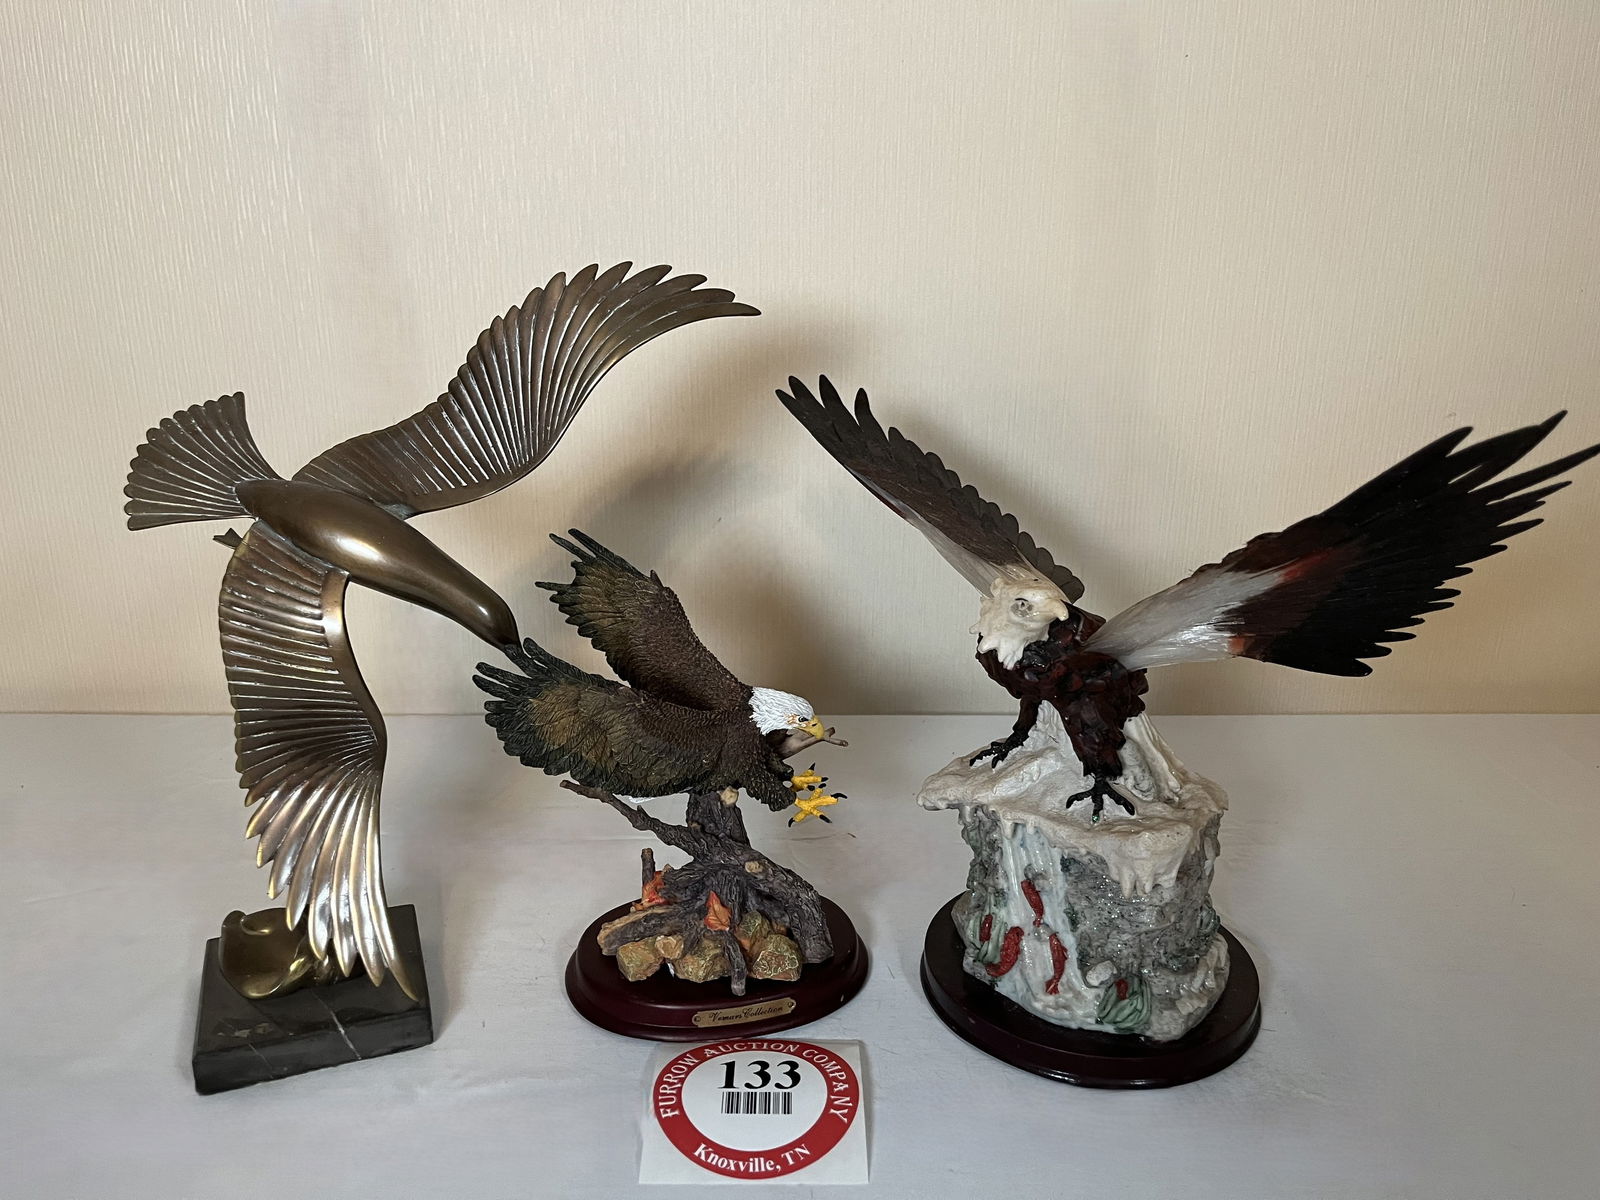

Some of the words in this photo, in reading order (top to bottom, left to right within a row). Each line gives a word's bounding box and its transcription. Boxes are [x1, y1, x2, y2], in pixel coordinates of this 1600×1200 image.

[742, 1007, 783, 1018] Collection
[658, 1053, 700, 1119] FURROW
[704, 1041, 799, 1058] AUCTION
[802, 1049, 853, 1123] COMPANY
[717, 1060, 802, 1090] 133
[693, 1143, 782, 1175] Knoxville,
[782, 1144, 812, 1167] TN
